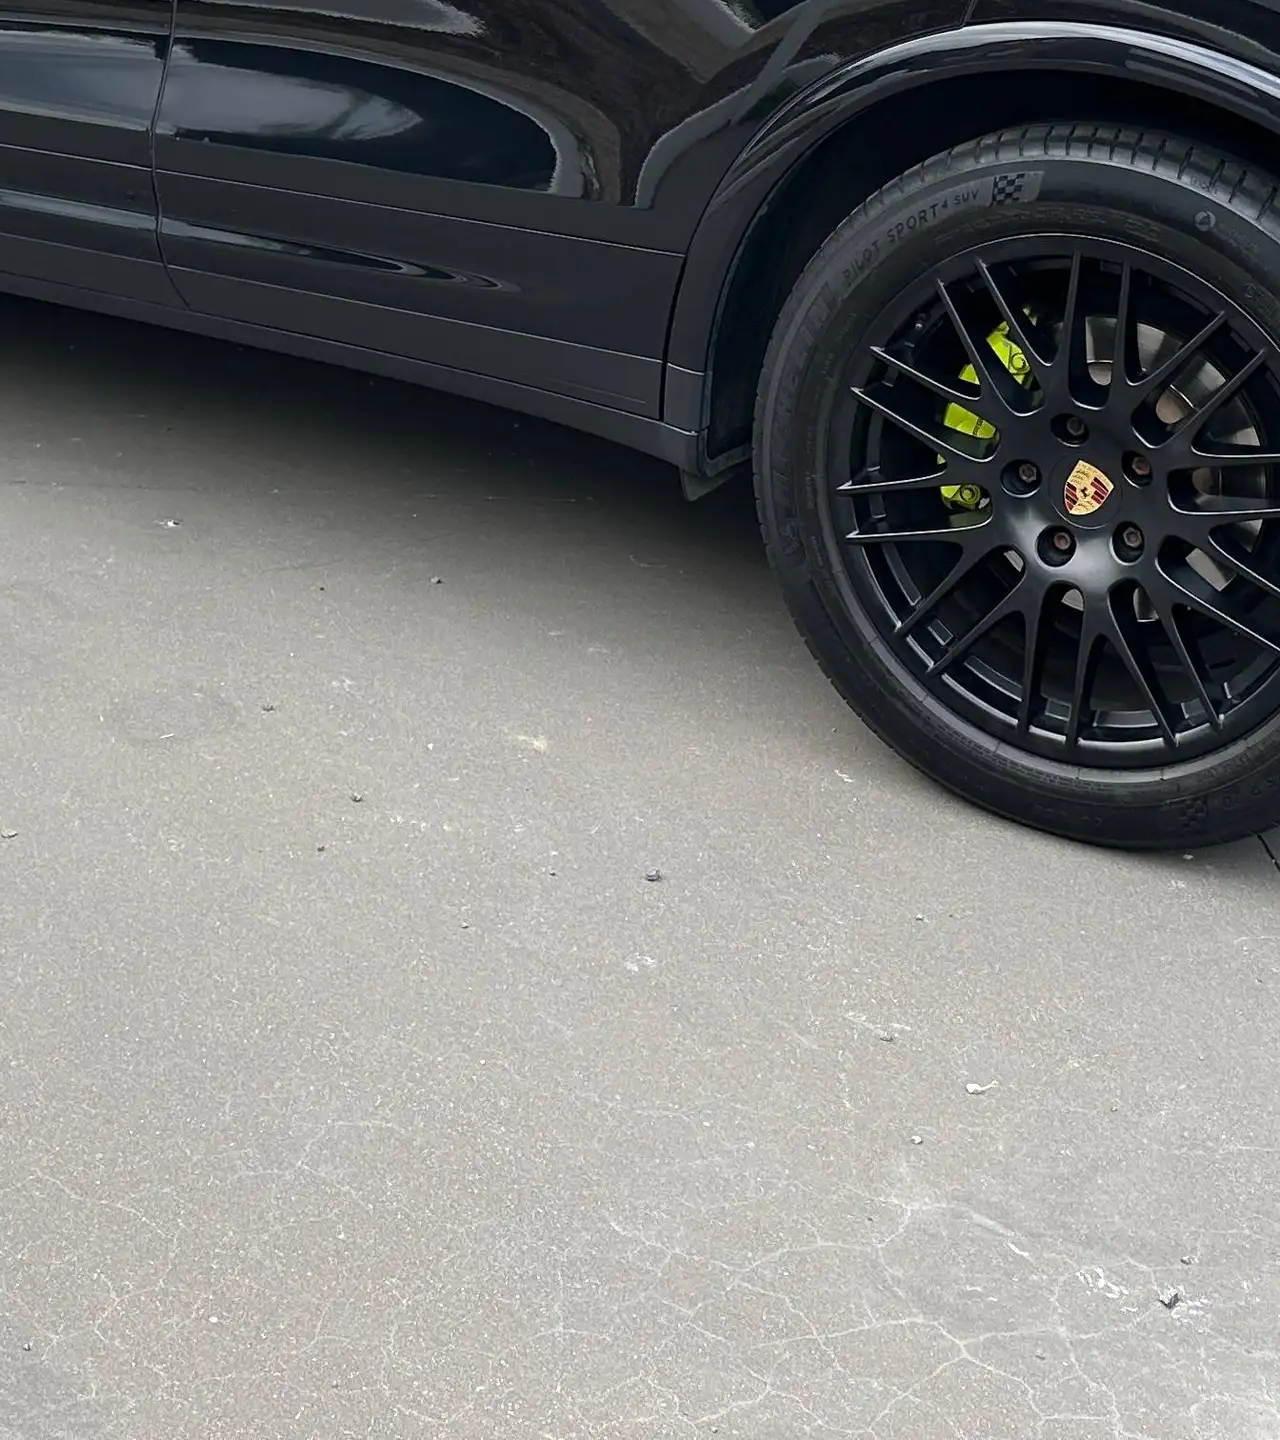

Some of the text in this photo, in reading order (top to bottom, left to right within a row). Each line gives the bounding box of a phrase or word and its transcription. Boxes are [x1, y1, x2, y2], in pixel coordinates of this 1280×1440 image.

[841, 239, 880, 288] PILOT
[886, 203, 939, 244] SPORT
[953, 189, 980, 205] SUV
